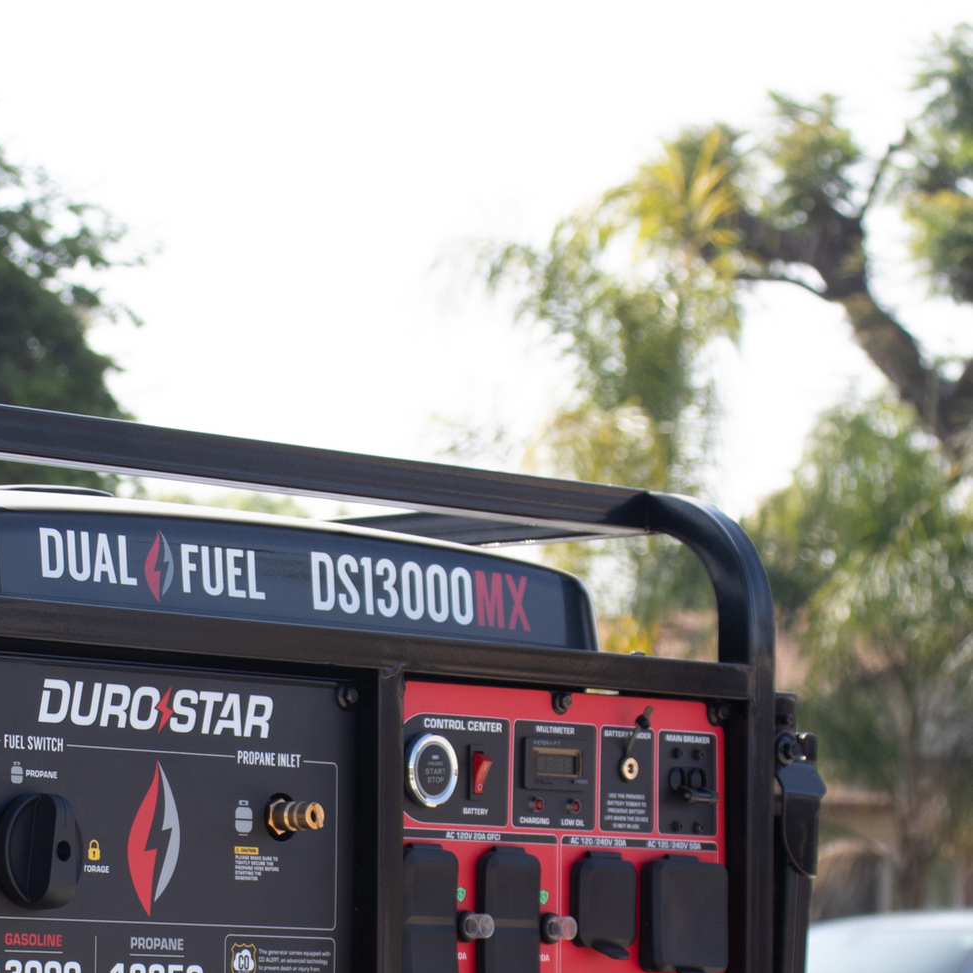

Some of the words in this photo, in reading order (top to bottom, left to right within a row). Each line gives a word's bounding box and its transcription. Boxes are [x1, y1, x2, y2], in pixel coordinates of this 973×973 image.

[38, 527, 138, 586] DUAL
[181, 543, 266, 600] FUEL
[310, 551, 532, 632] DS13000MX
[424, 718, 466, 730] CONTROL
[467, 721, 502, 733] CENTER
[536, 725, 575, 735] MULTIMETER
[604, 730, 628, 738] BATTERY
[629, 731, 651, 740] TNDER
[666, 734, 682, 743] MAIN
[683, 735, 710, 744] BREAKER
[4, 734, 26, 750] FUEL
[27, 736, 64, 752] SWITCH
[237, 750, 276, 766] PROPANE
[278, 753, 301, 768] INLET
[25, 769, 58, 779] PROPANE
[463, 807, 488, 815] BATTERY
[520, 816, 550, 825] CHARGING
[561, 818, 574, 826] LOW
[446, 831, 455, 839] AC
[456, 832, 472, 840] 120V
[473, 833, 486, 841] 20A
[487, 833, 501, 841] GFCI
[570, 837, 579, 845] AC
[614, 838, 627, 847] 30A
[647, 840, 657, 848] AC
[689, 842, 702, 850] 50A
[4, 933, 63, 947] GASOLINE
[130, 936, 184, 951] PROPANE
[458, 952, 467, 960] 0A
[238, 954, 250, 970] CO
